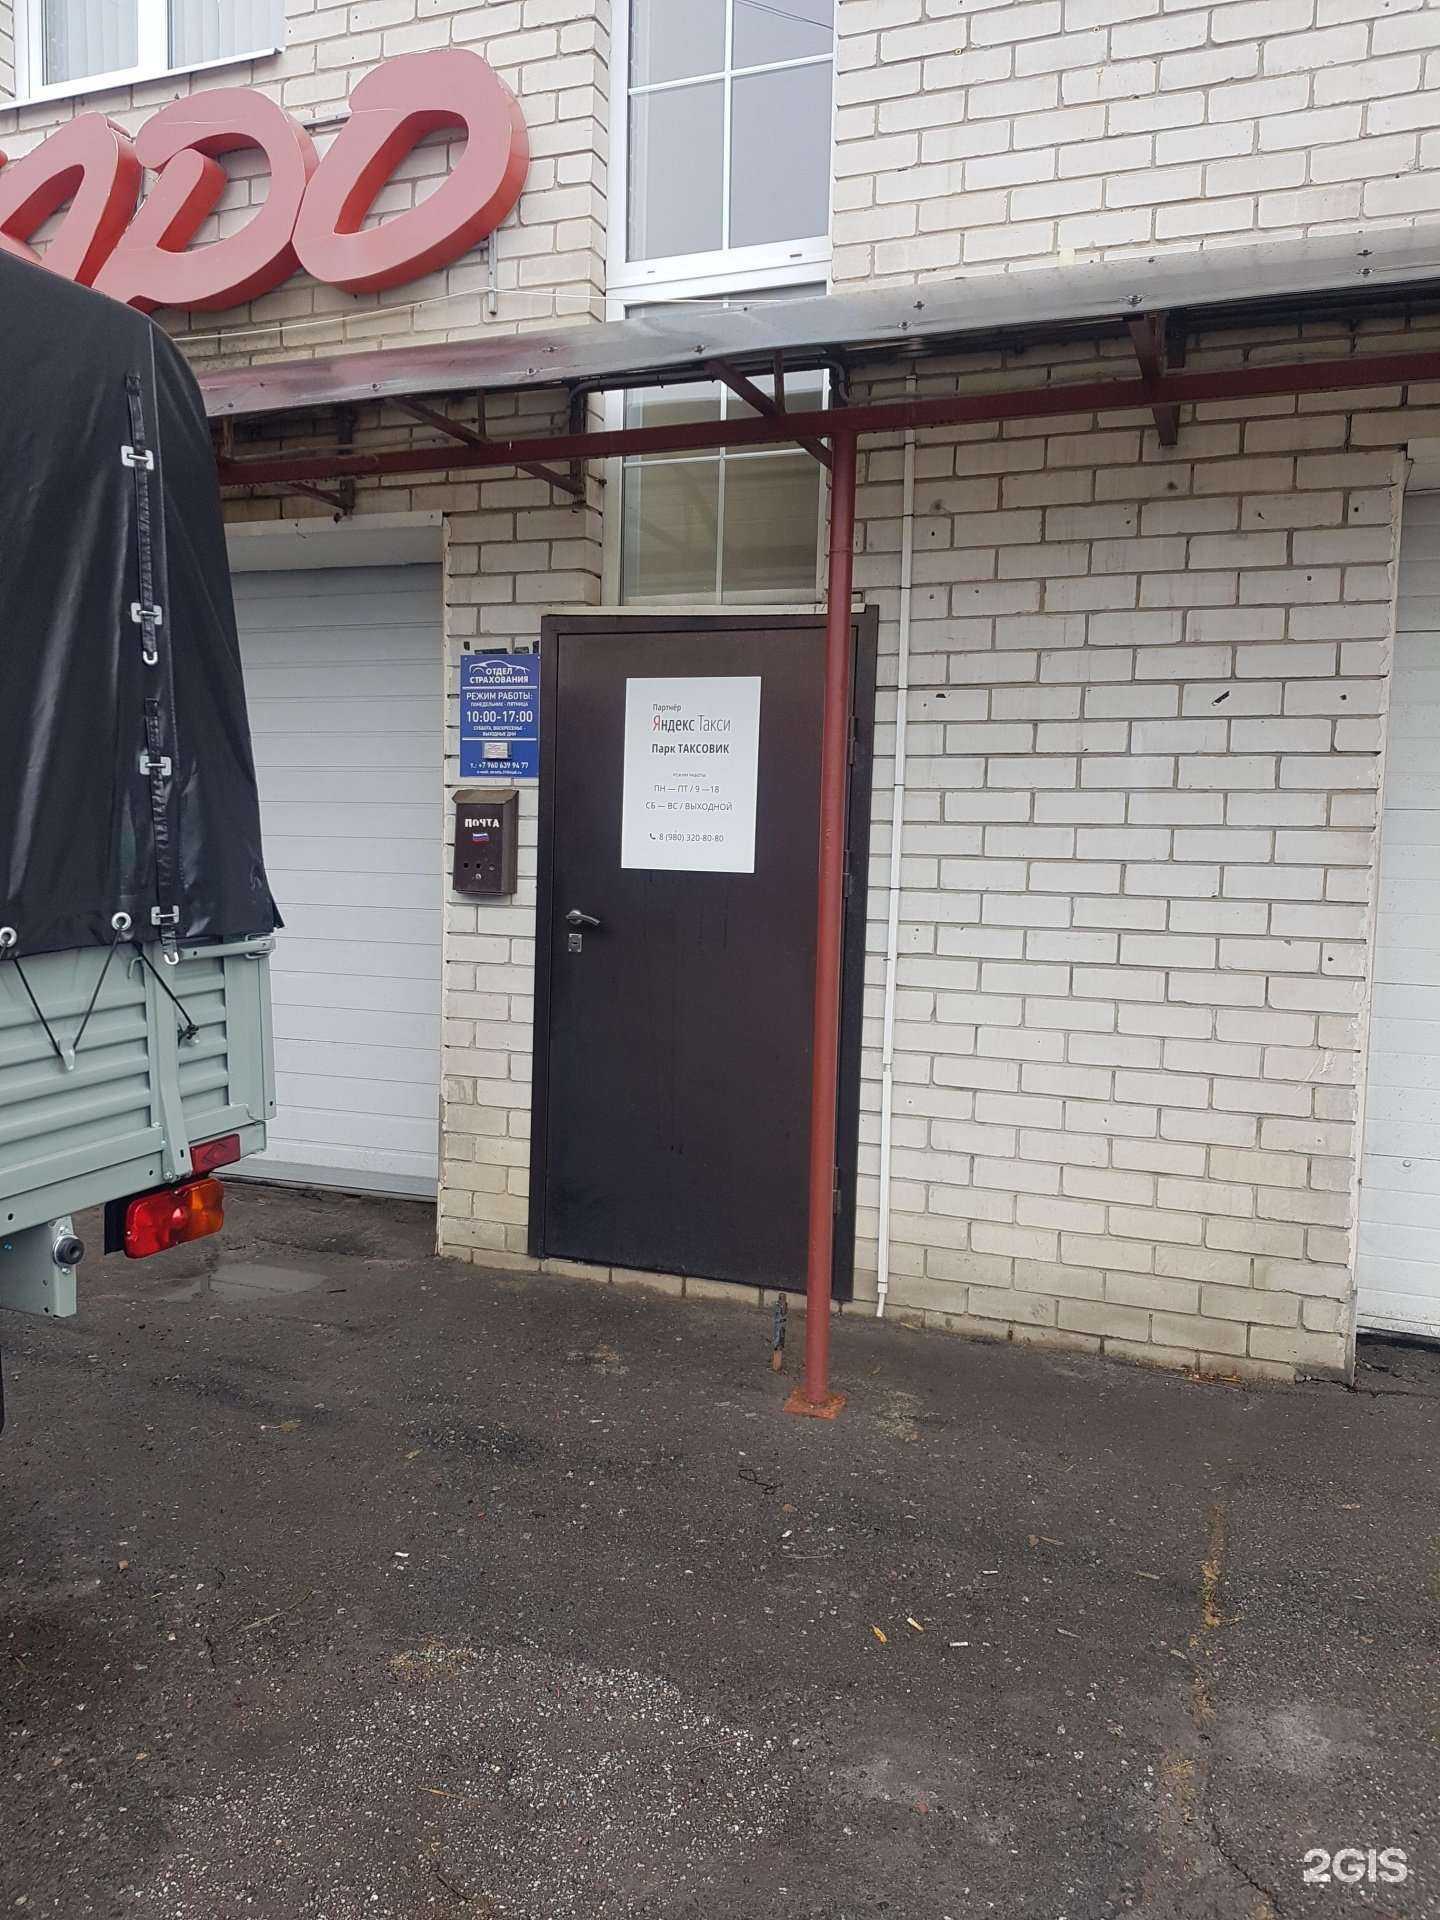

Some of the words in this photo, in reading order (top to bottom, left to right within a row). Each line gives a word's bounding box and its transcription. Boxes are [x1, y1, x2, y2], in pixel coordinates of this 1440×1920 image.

[485, 667, 513, 676] ОТДЕЛ
[469, 675, 529, 684] СТРАХОВАНИЯ
[466, 691, 496, 701] РЕЖИМ
[652, 703, 682, 713] Партнёр
[652, 714, 695, 734] Яндекс
[696, 714, 731, 732] Такси
[651, 743, 676, 756] Парк
[678, 743, 730, 754] ТАКСОВИК
[654, 784, 666, 793] ПН
[677, 784, 688, 793] ПТ
[645, 801, 656, 810] СБ
[667, 801, 678, 810] ВС
[684, 801, 733, 812] ВЫХОДНОЙ
[464, 818, 500, 828] ПОЧТА
